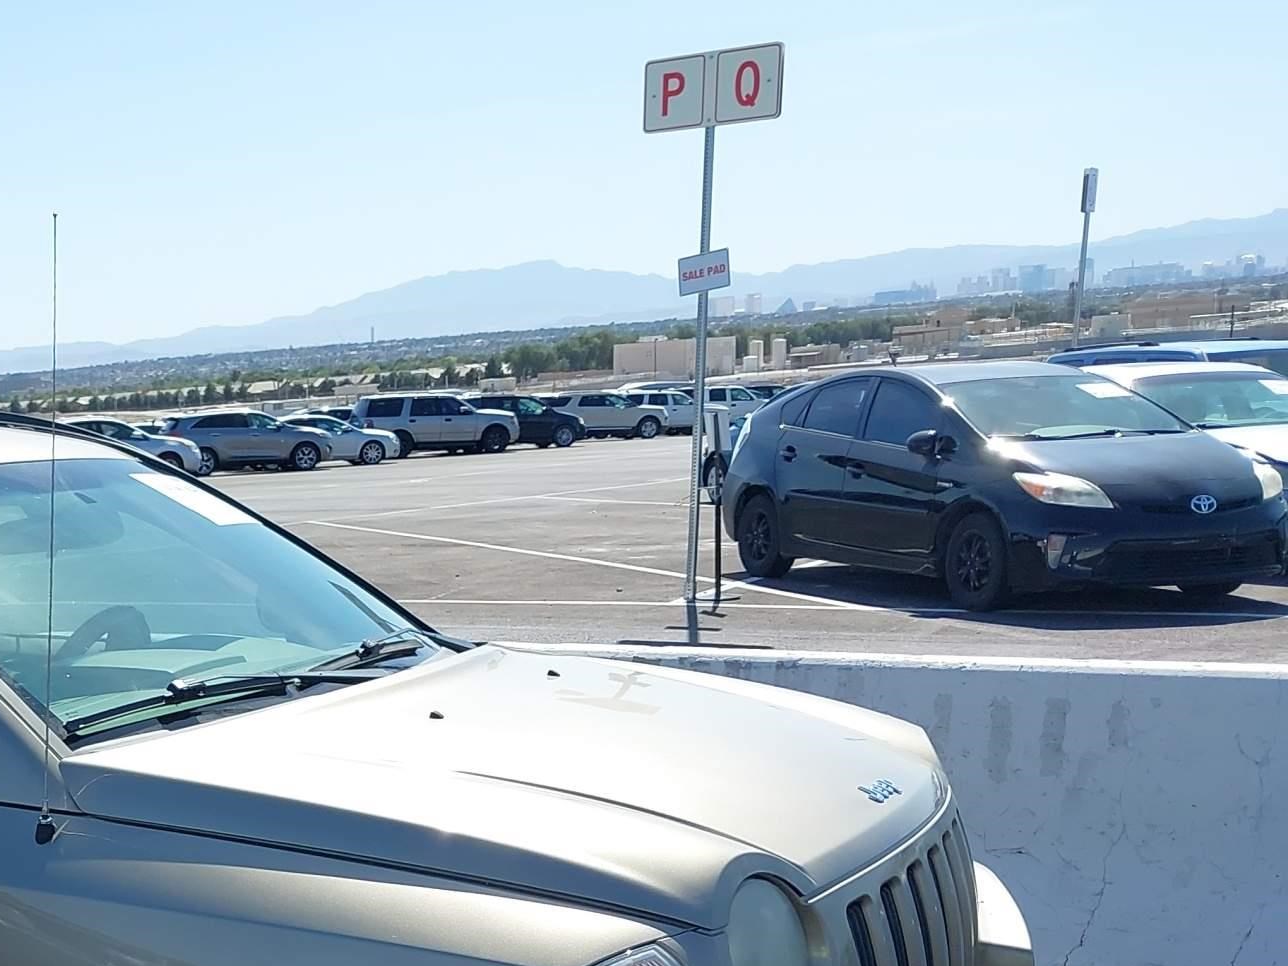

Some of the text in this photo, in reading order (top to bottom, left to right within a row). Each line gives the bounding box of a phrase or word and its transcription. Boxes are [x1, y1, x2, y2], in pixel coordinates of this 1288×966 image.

[661, 71, 685, 117] P
[734, 60, 761, 107] Q
[681, 263, 726, 282] SALE PAD
